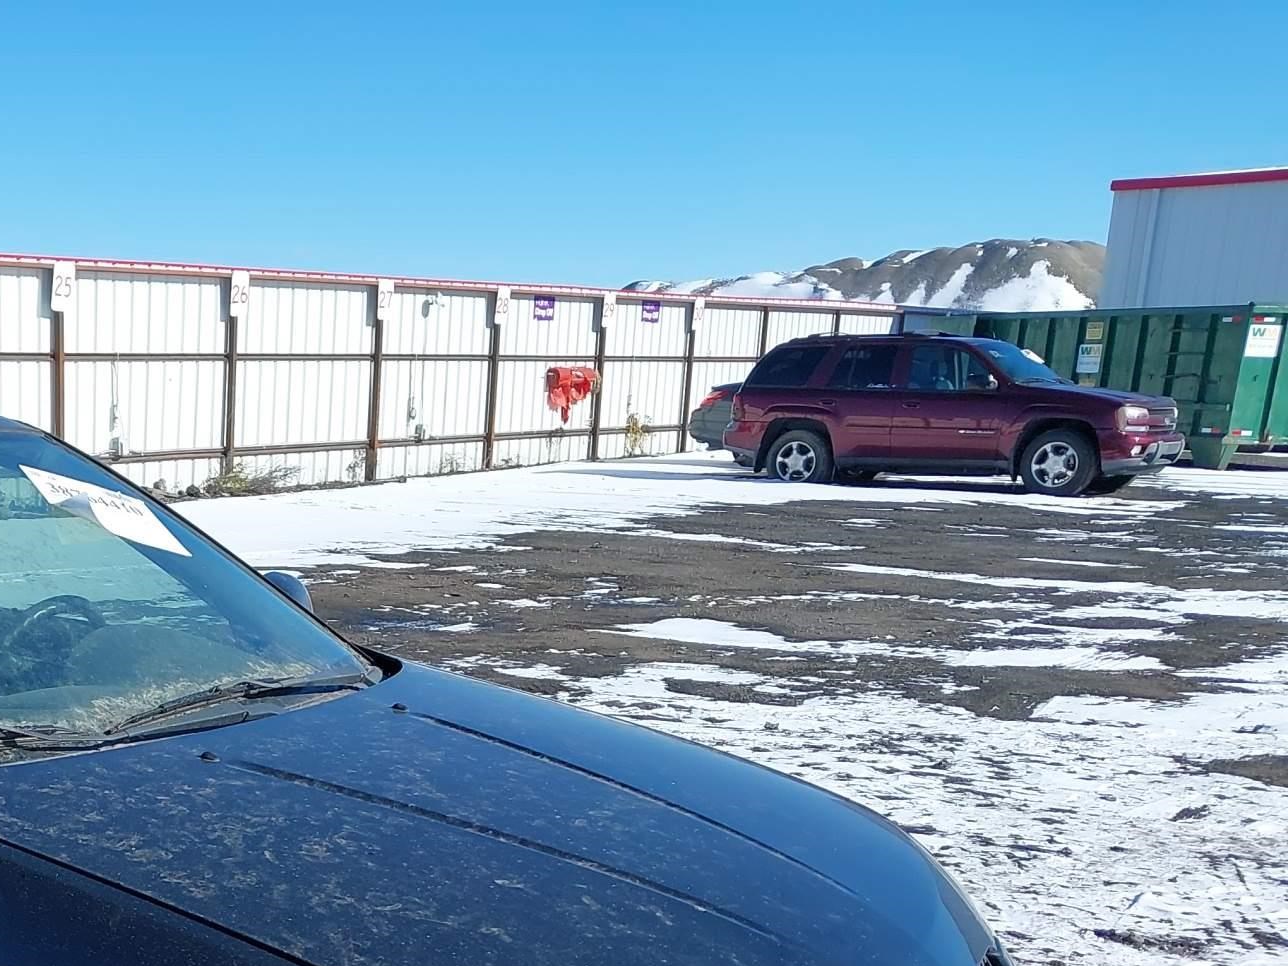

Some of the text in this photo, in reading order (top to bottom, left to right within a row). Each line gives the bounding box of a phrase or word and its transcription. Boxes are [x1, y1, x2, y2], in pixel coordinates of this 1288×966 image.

[54, 274, 72, 298] 25
[231, 284, 248, 304] 26
[379, 290, 393, 308] 27
[497, 297, 509, 314] 28
[603, 302, 615, 319] 29
